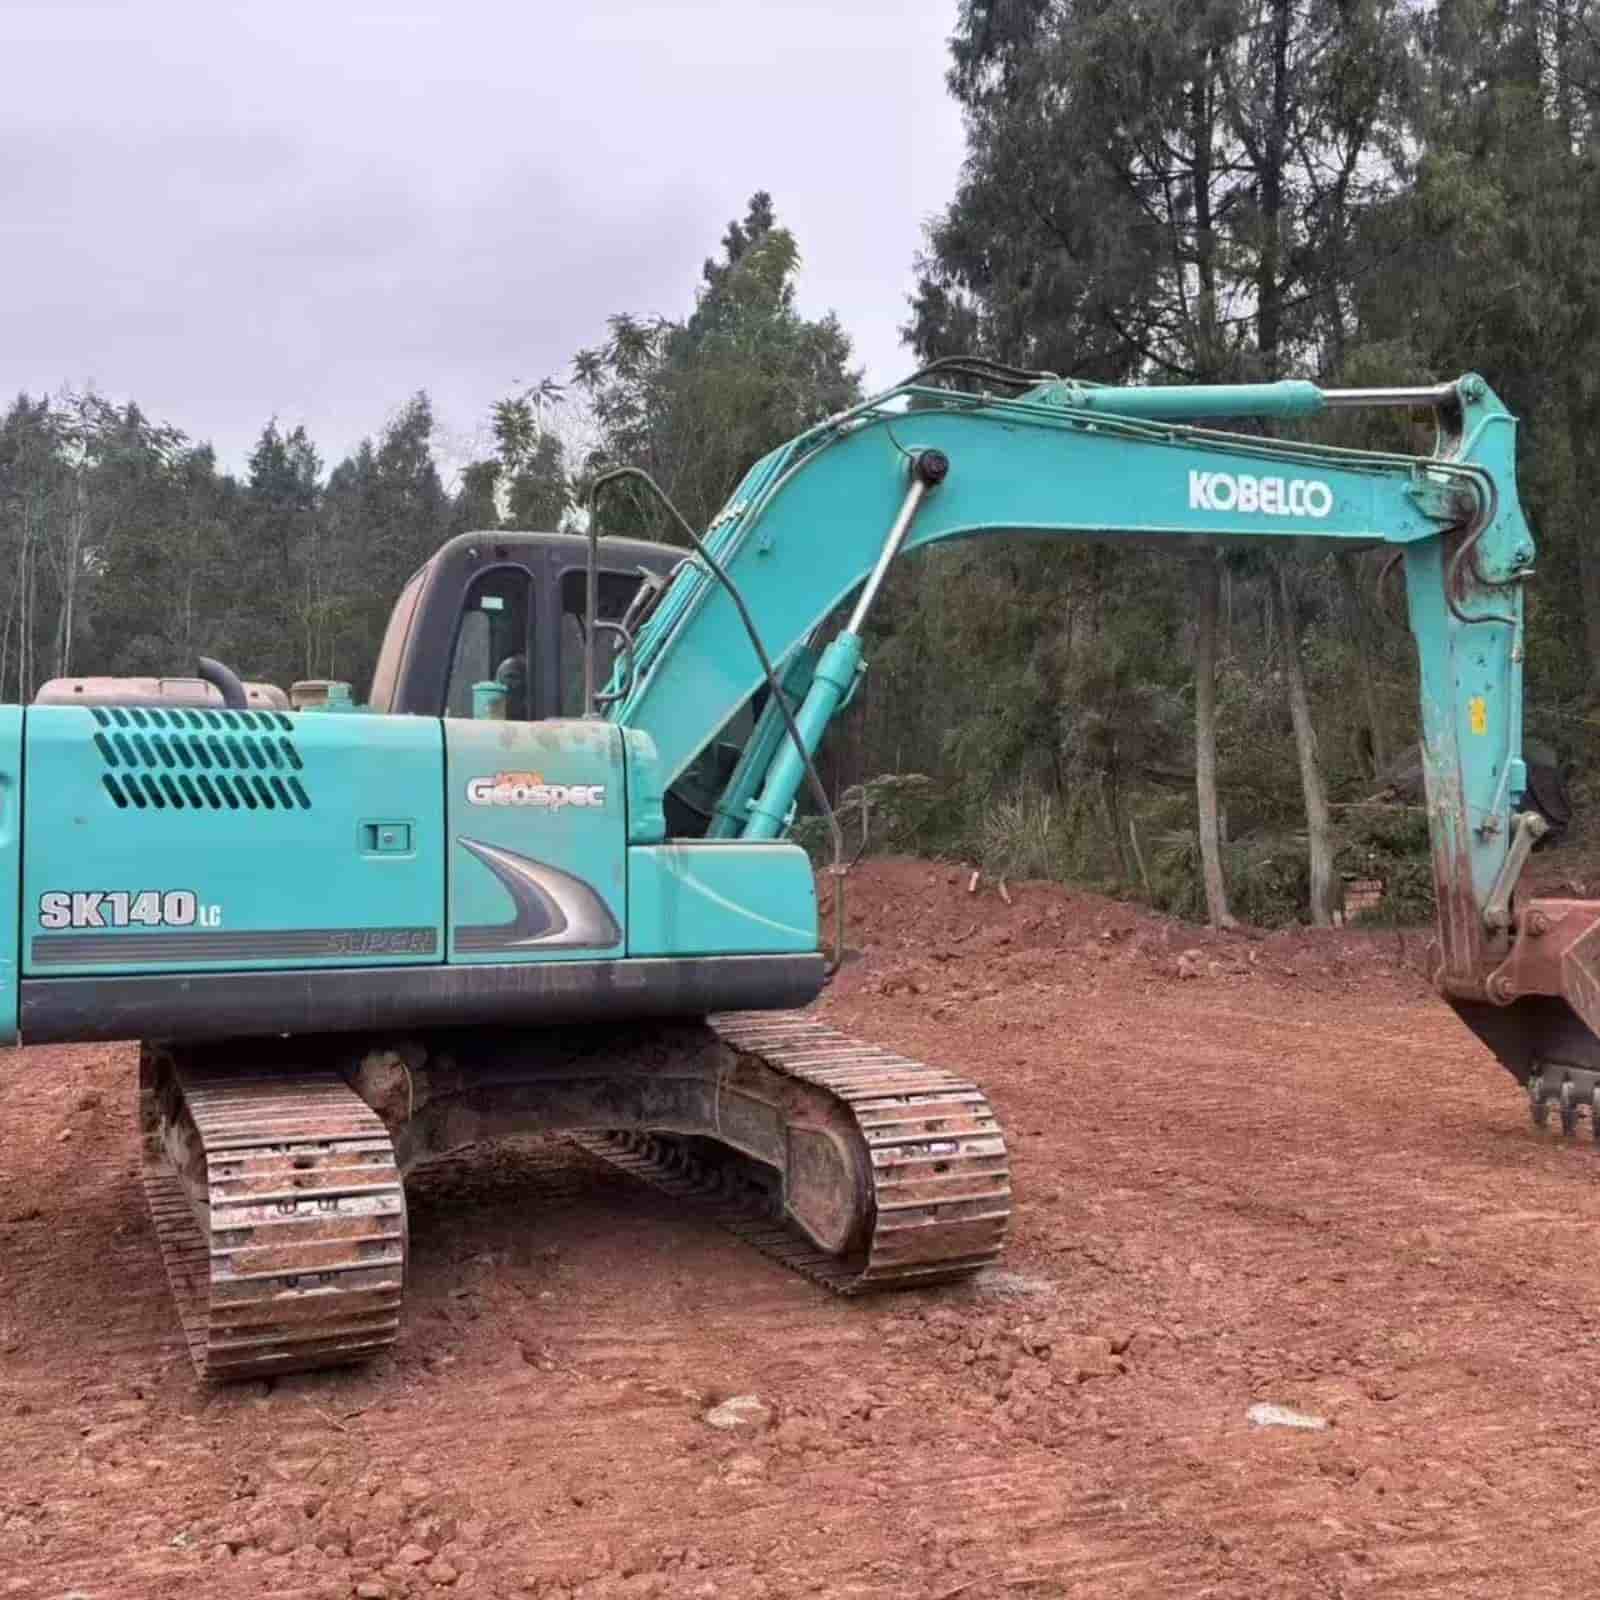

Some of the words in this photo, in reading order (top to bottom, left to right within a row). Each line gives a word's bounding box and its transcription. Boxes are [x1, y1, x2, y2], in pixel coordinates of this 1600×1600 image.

[1189, 470, 1333, 517] KOBELCO
[467, 776, 606, 812] Geospec
[39, 890, 197, 928] SK140
[199, 904, 222, 927] LC
